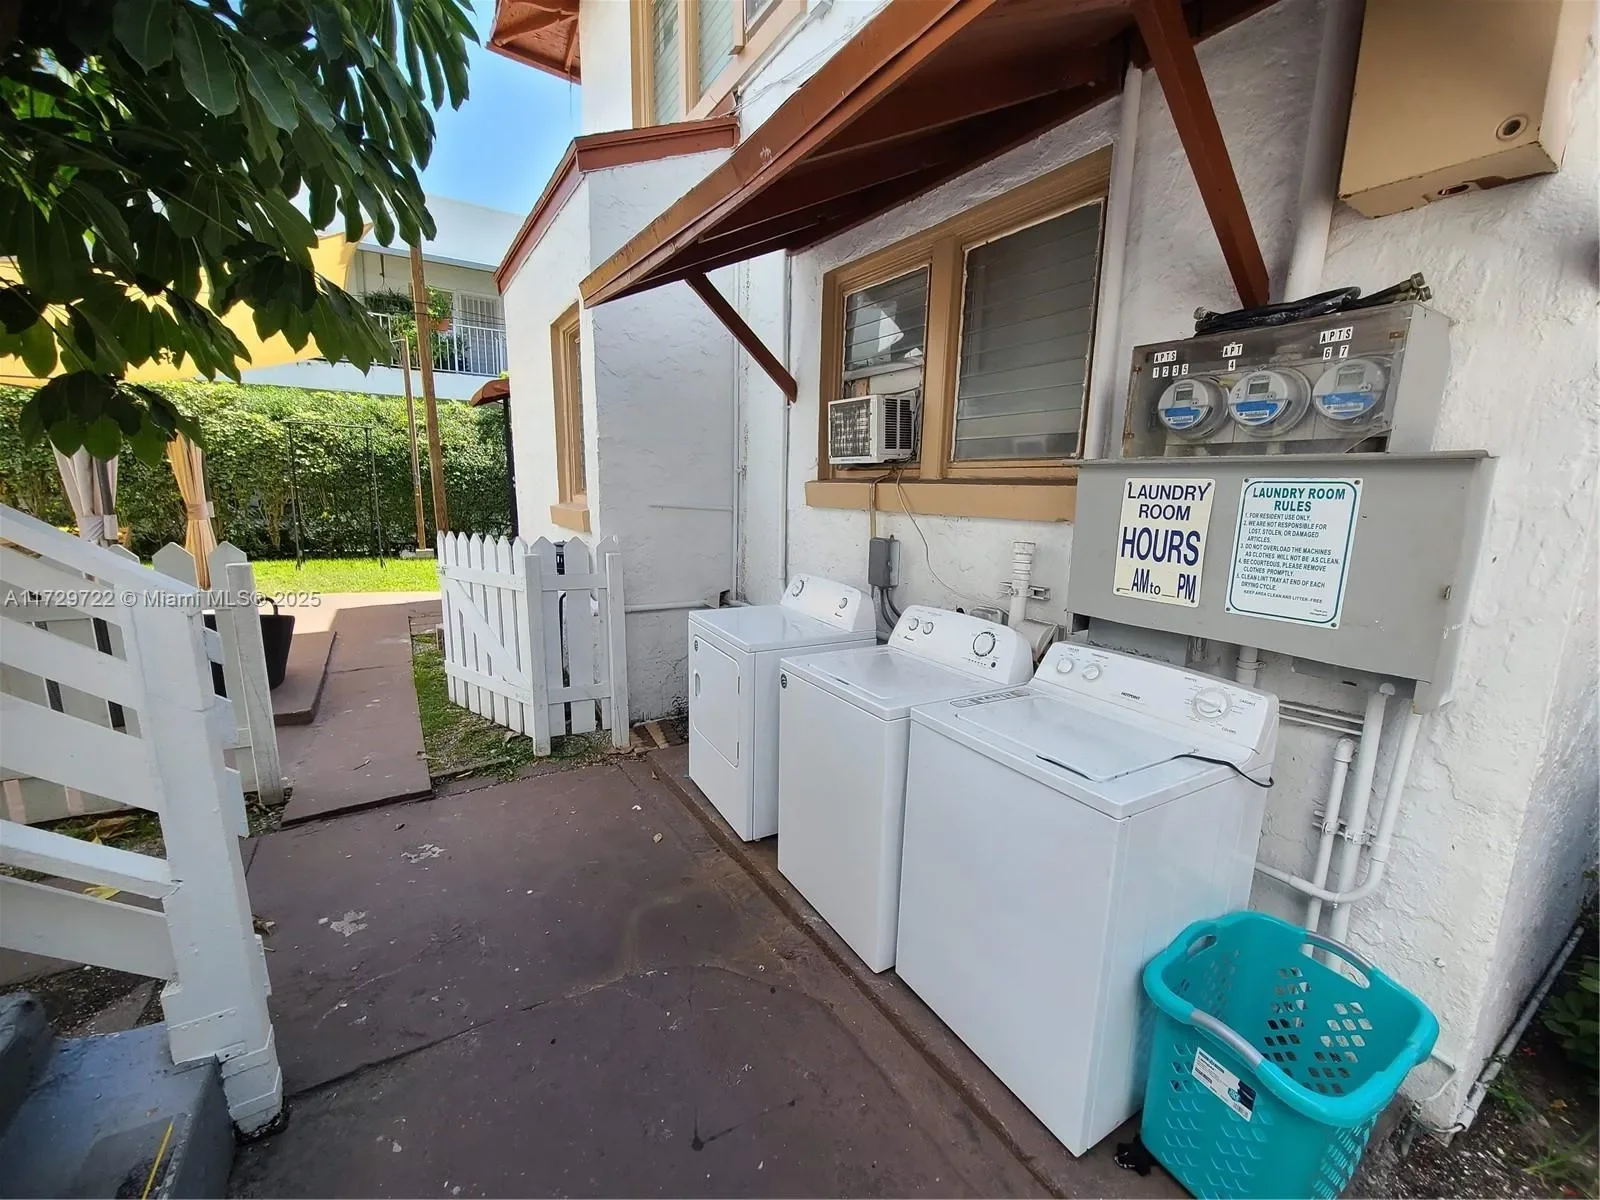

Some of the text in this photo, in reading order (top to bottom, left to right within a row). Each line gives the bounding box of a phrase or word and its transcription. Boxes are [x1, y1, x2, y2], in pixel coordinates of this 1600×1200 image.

[1321, 329, 1351, 342] APTS
[1154, 352, 1176, 362] APTS
[1223, 346, 1242, 357] APT
[1324, 346, 1349, 359] 6 7
[1163, 367, 1169, 376] 2
[1173, 366, 1179, 375] 3
[1182, 365, 1188, 374] 5
[1229, 360, 1235, 370] 4
[1128, 484, 1209, 500] LAUNDRY
[1253, 487, 1345, 500] LAUNDRY ROOM
[1139, 504, 1191, 520] ROOM
[1274, 501, 1312, 512] RULES
[1278, 522, 1314, 530] RESPONSIBLE
[1121, 527, 1200, 566] HOURS
[1302, 547, 1332, 556] MACHINES
[1253, 551, 1275, 559] CLOTHES
[1243, 566, 1265, 574] CLOTHES
[1282, 562, 1302, 570] PLEASE
[1303, 563, 1326, 572] REMOVE
[1131, 568, 1197, 600] AM to PM
